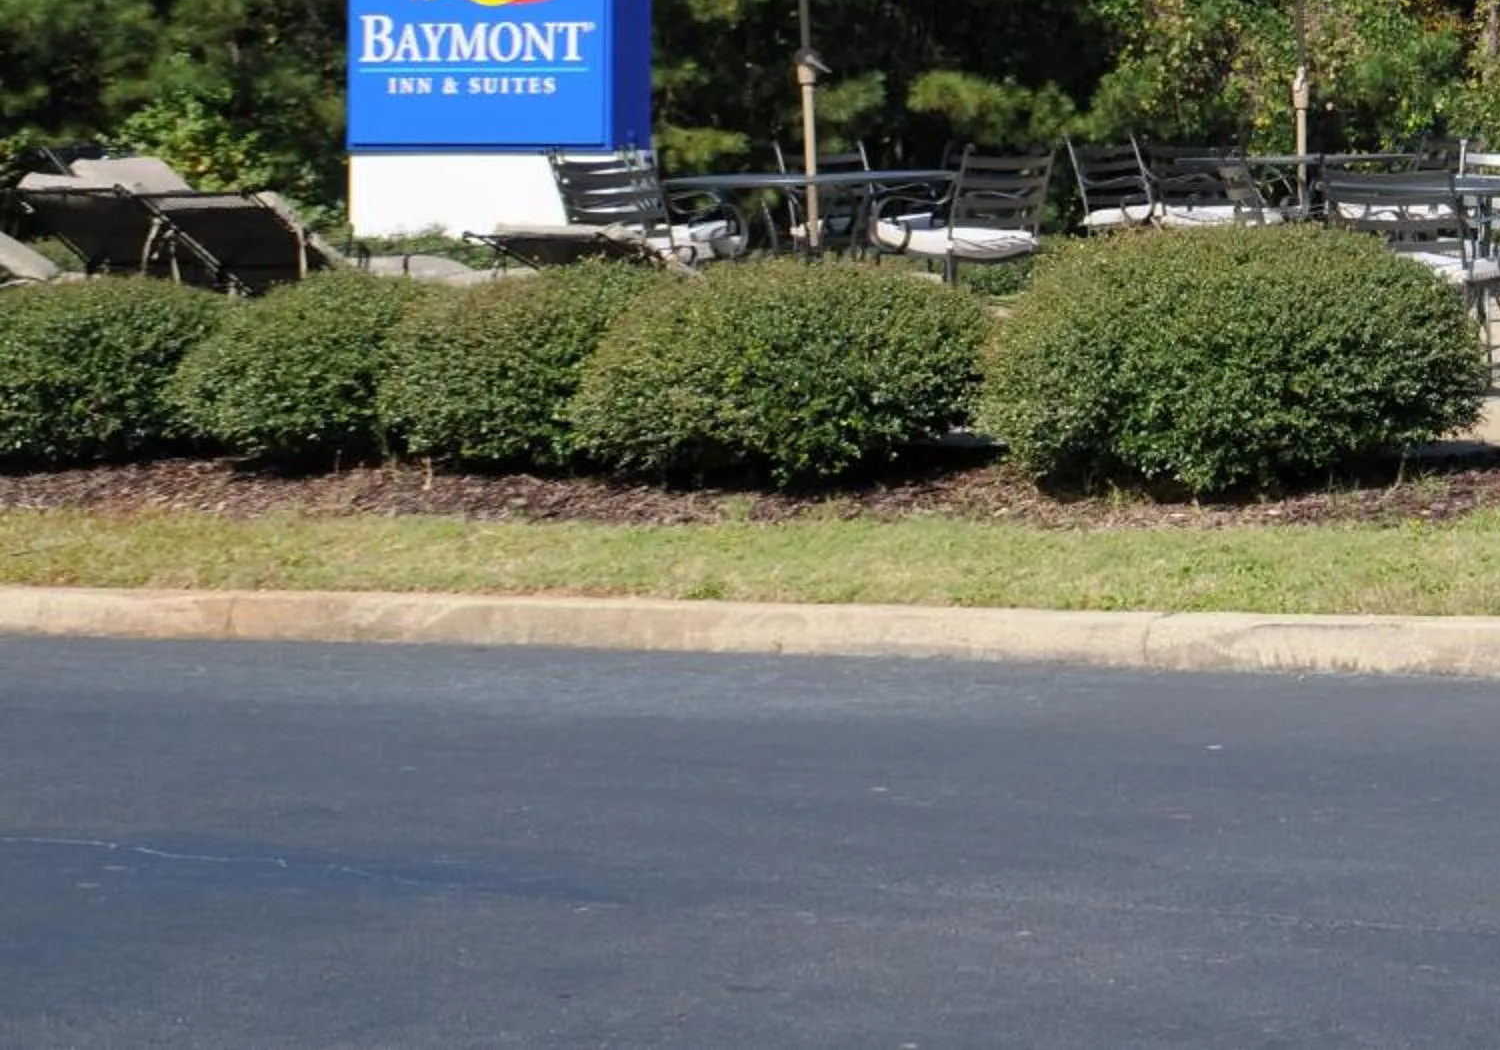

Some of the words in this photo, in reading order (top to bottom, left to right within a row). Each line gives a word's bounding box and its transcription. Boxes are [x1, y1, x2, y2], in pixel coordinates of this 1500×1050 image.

[360, 15, 591, 61] BAYMONT
[388, 77, 432, 94] INN
[442, 77, 459, 94] &
[468, 77, 556, 94] SUITES
